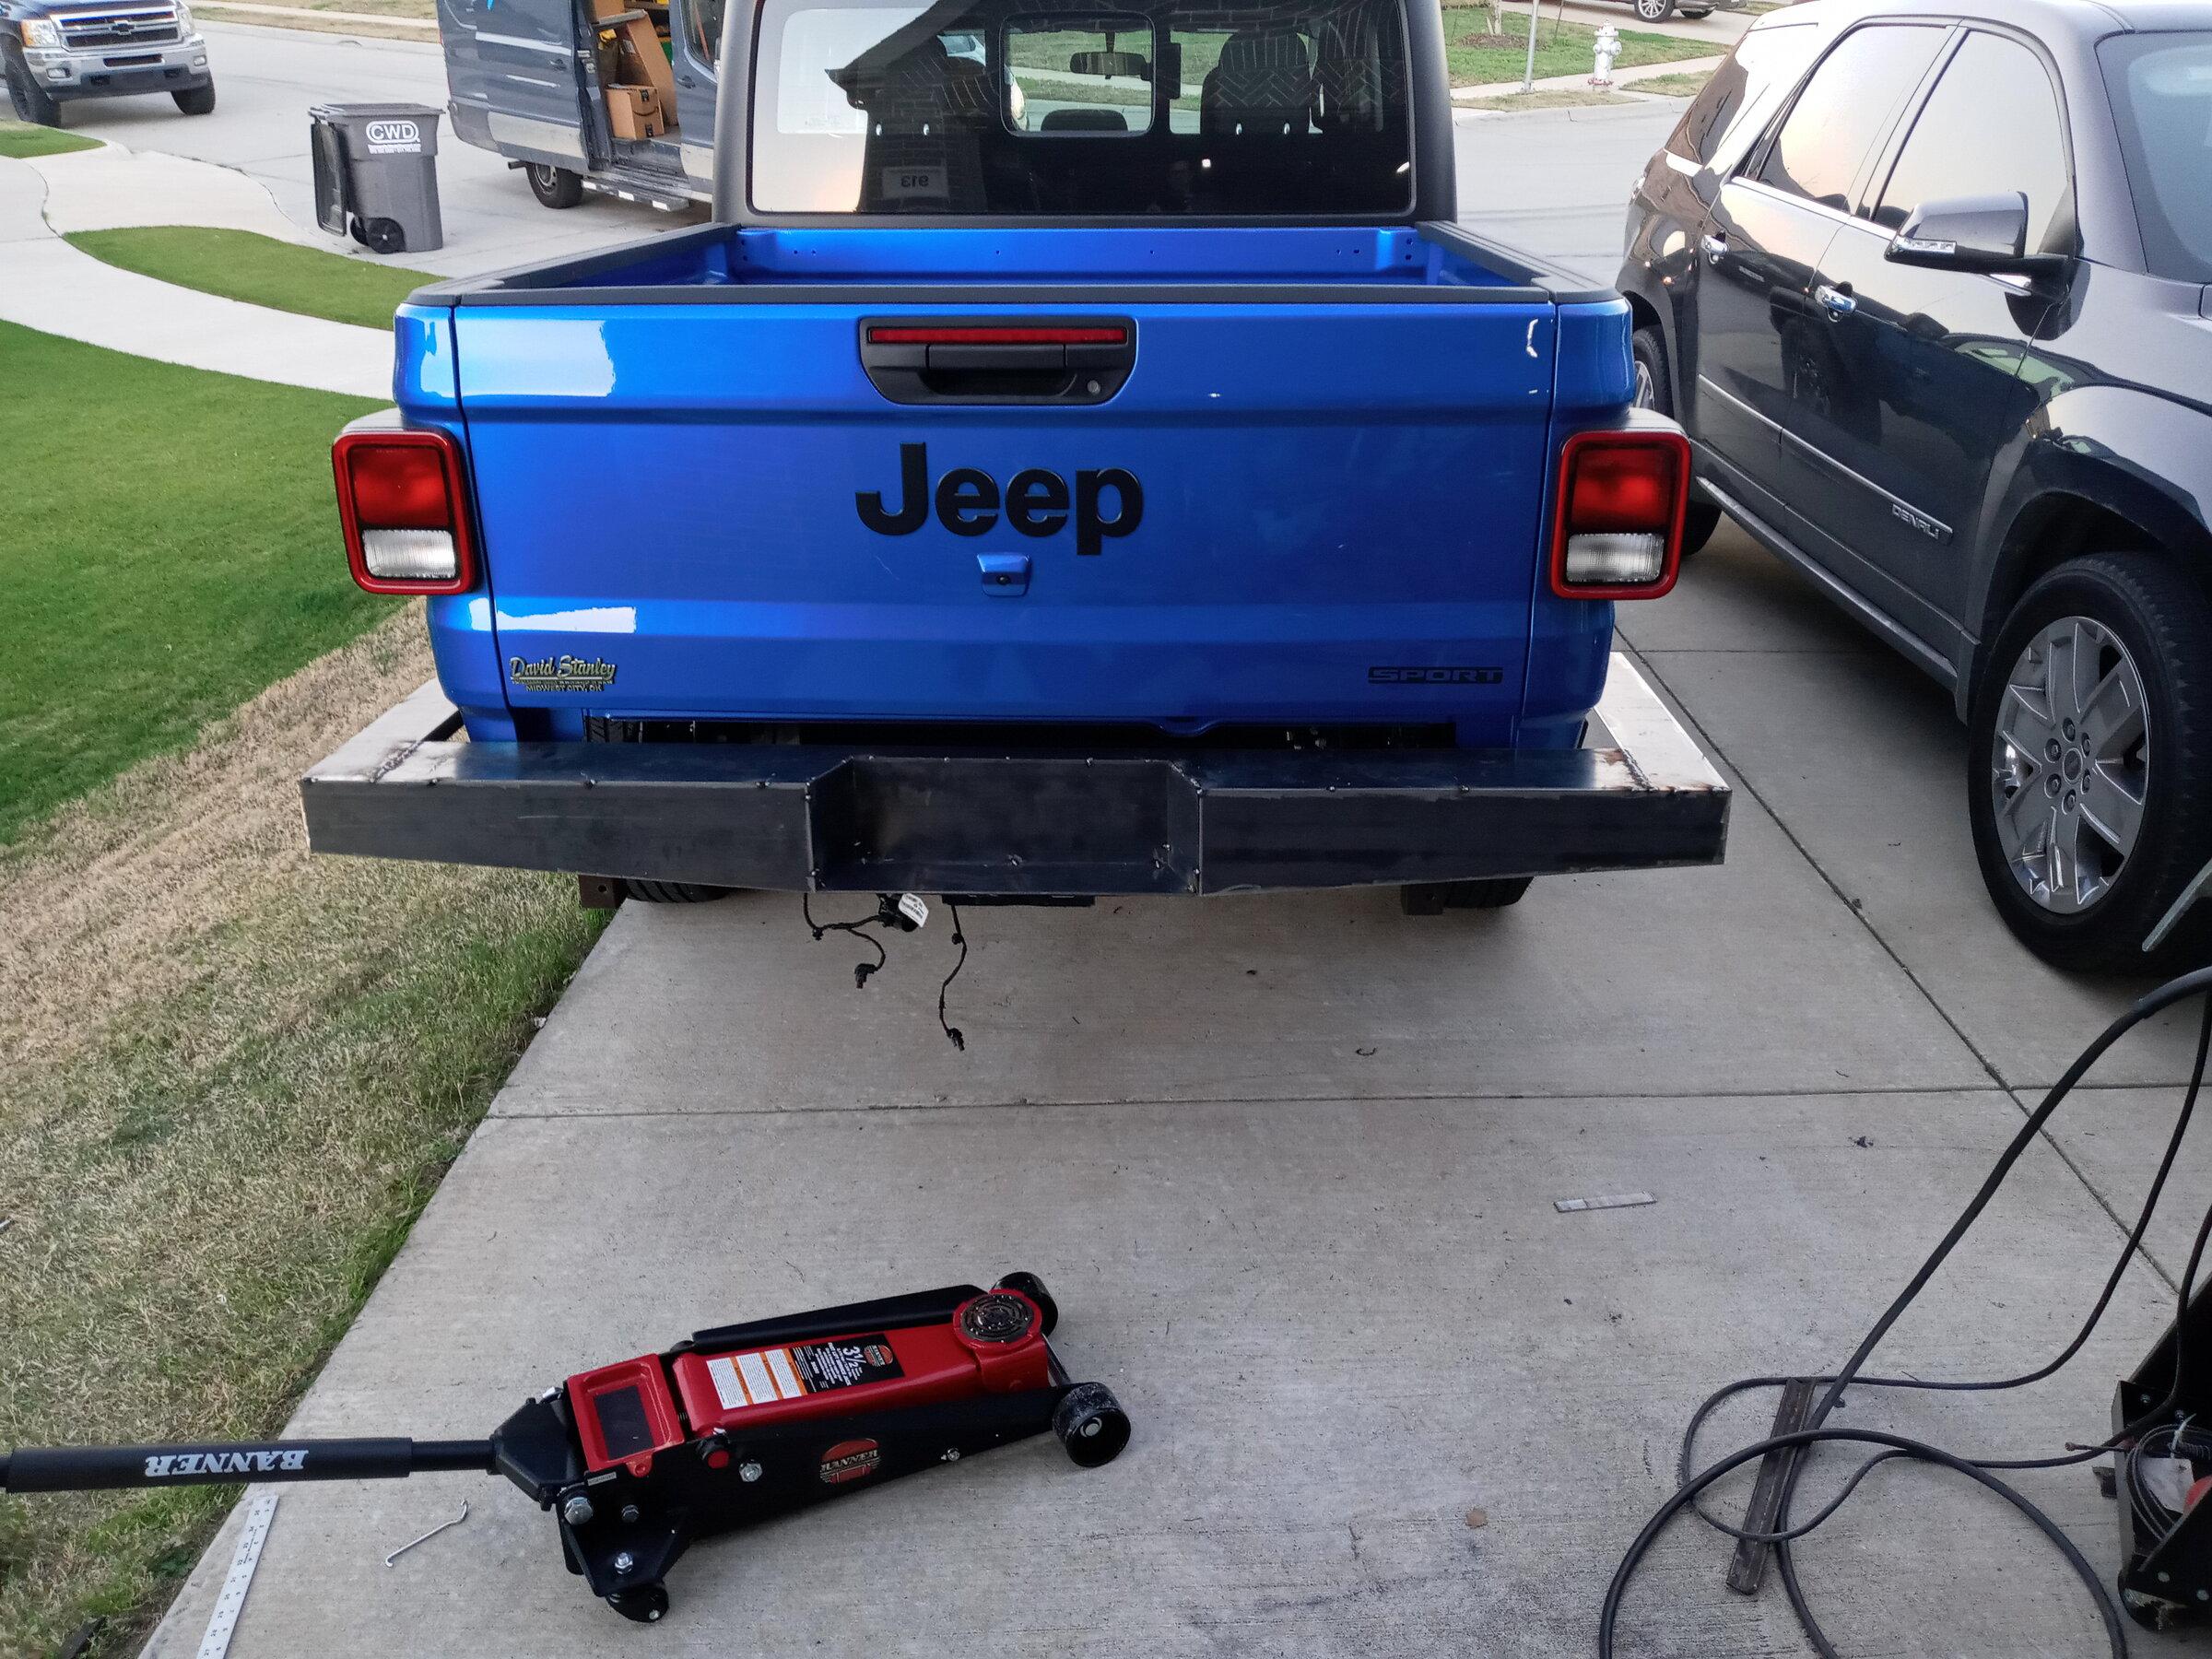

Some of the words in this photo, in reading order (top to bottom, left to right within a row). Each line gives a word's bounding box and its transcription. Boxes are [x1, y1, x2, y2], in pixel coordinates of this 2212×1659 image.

[371, 124, 416, 140] CWD
[854, 441, 1143, 556] Jeep
[1892, 503, 1939, 539] DENALI
[510, 656, 555, 677] David
[557, 654, 616, 680] Stanley
[1369, 669, 1503, 681] SPORT
[145, 1450, 309, 1477] BANNER
